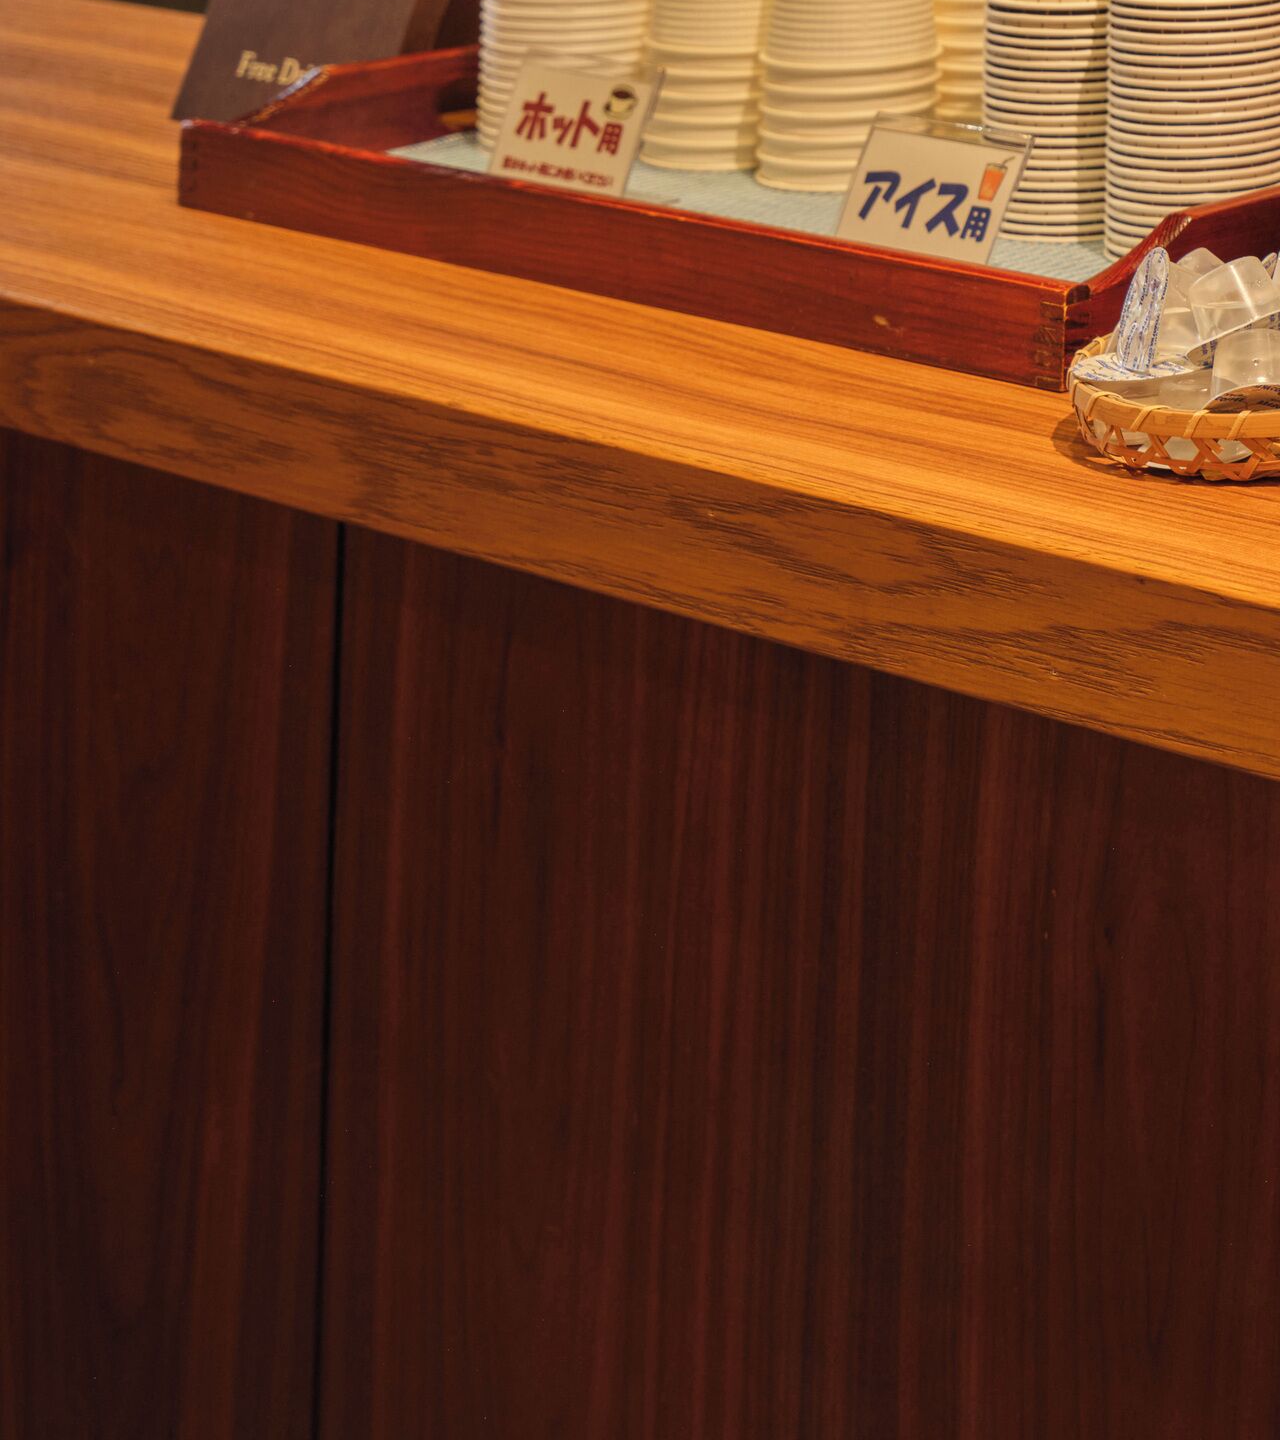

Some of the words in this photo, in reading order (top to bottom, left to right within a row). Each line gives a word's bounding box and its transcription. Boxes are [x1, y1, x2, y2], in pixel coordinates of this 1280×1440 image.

[515, 91, 624, 156] ホット用
[858, 171, 991, 243] アイス用
